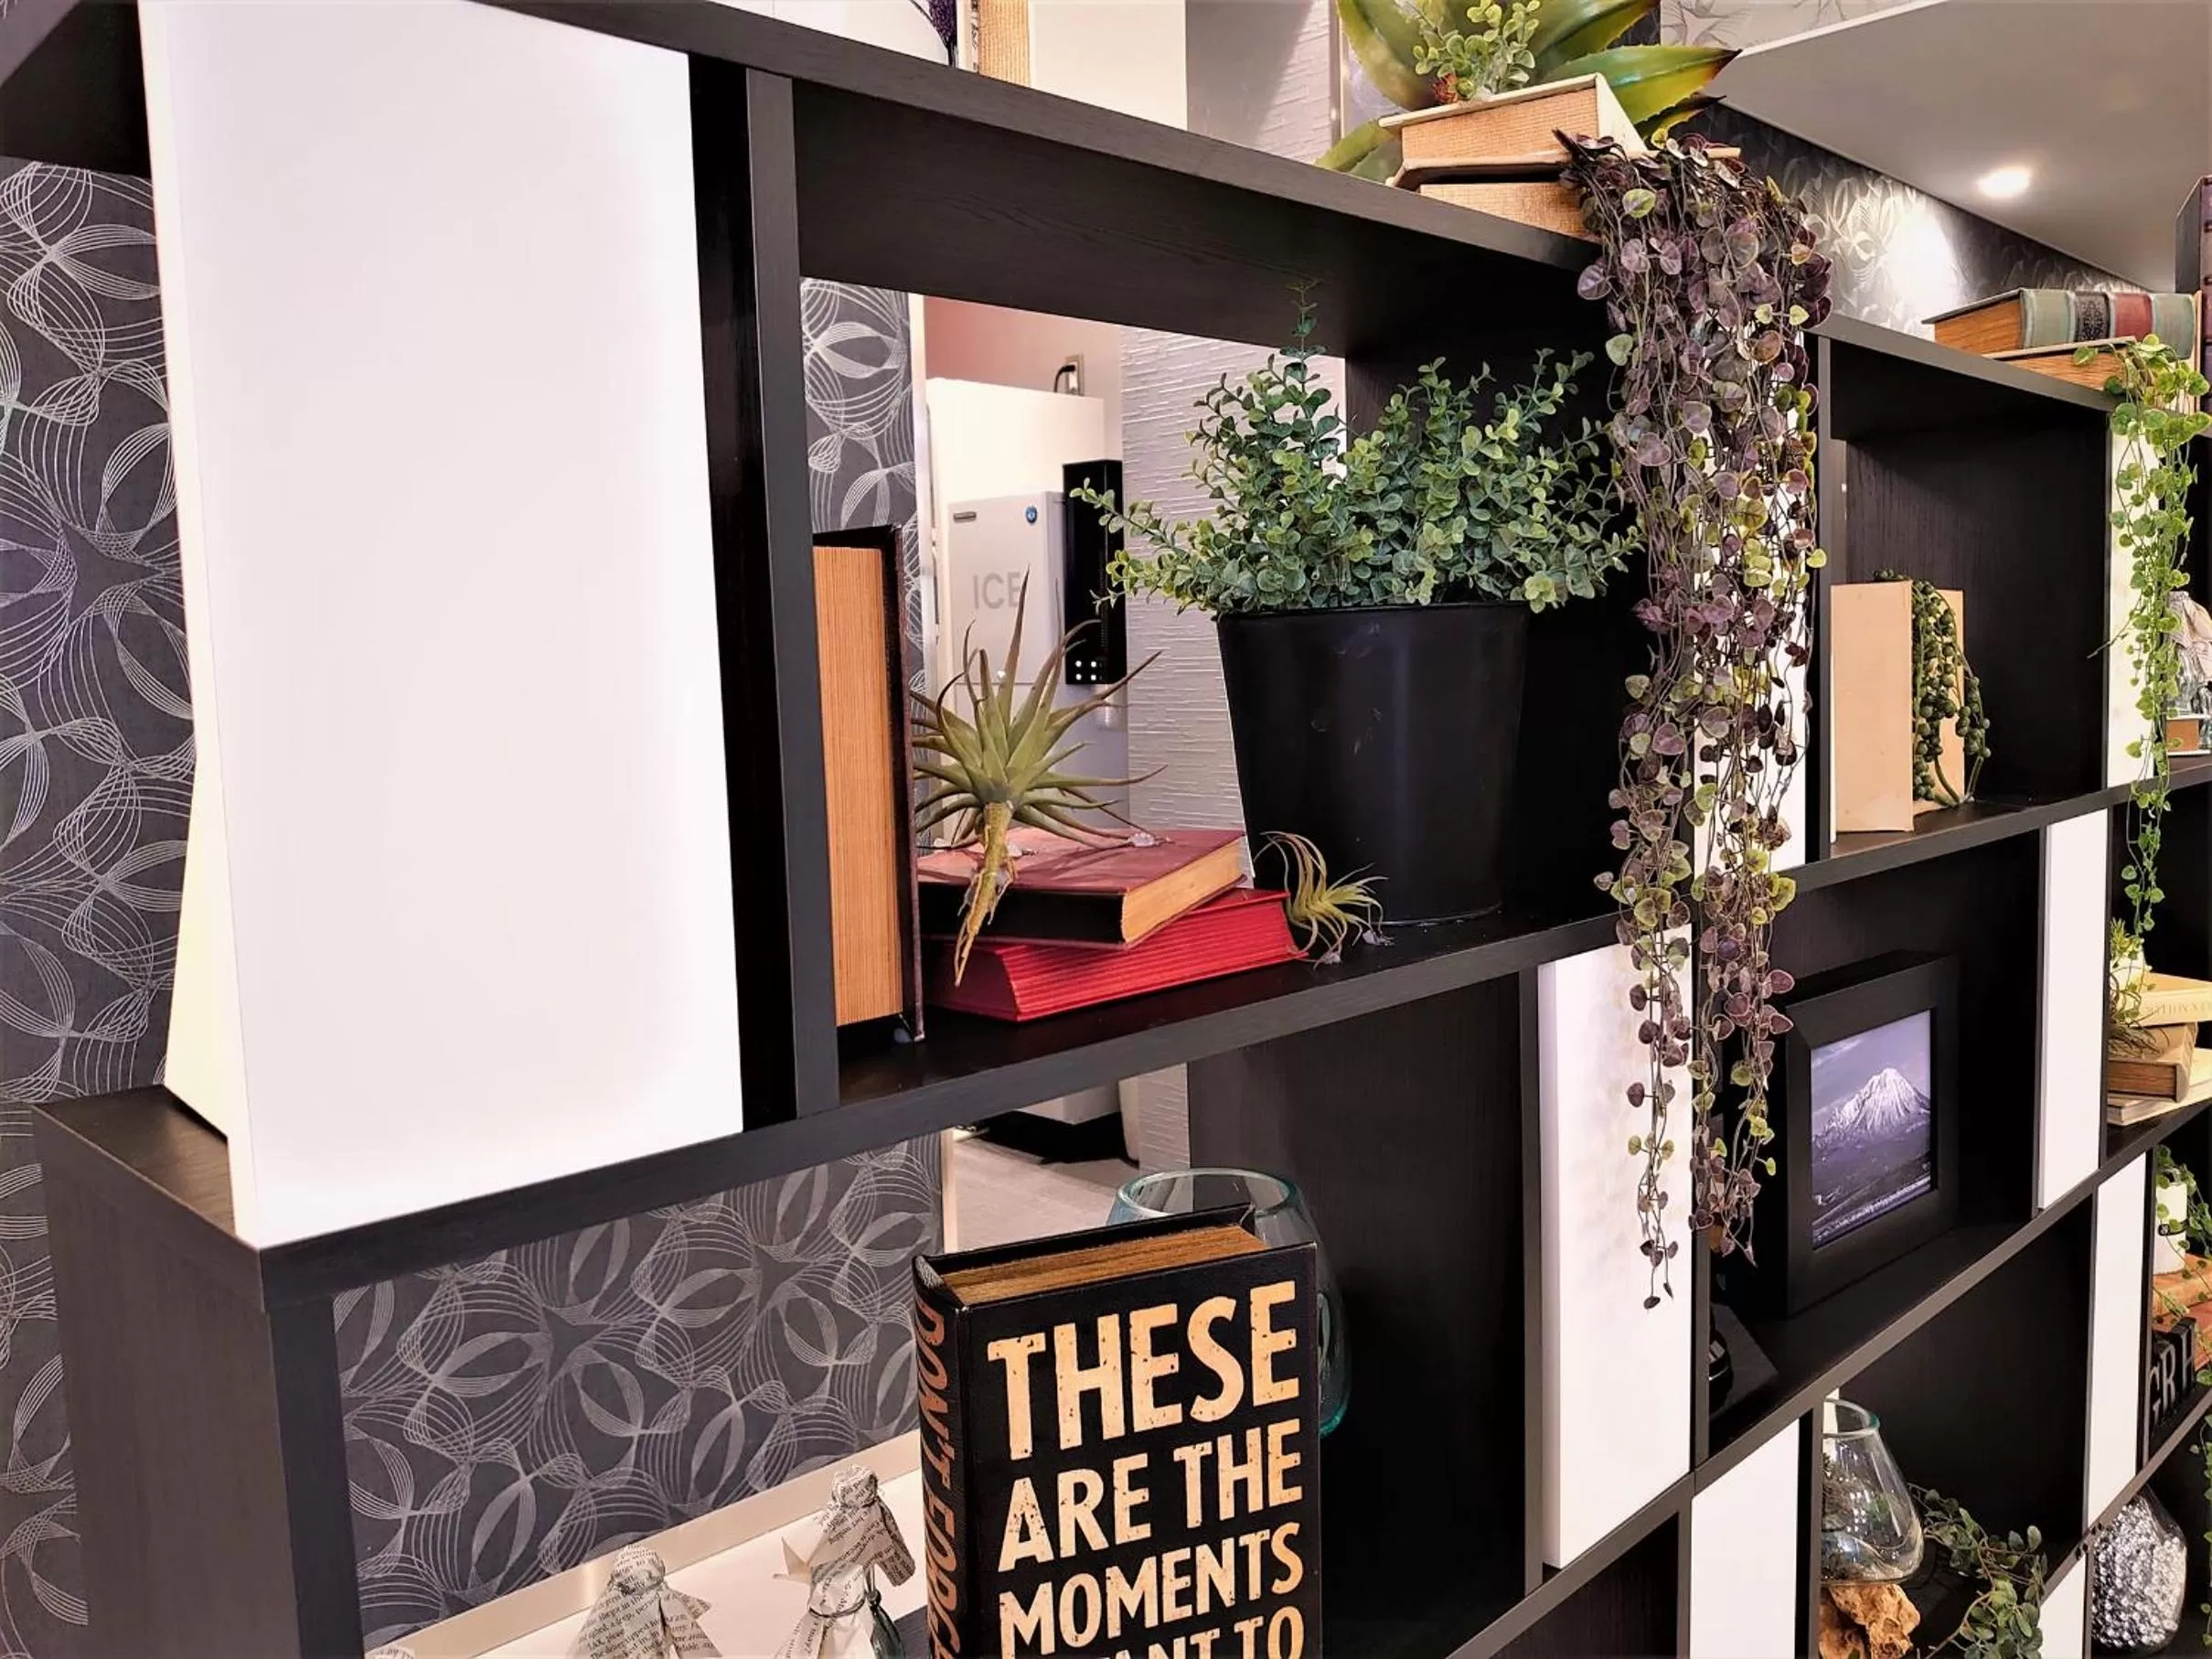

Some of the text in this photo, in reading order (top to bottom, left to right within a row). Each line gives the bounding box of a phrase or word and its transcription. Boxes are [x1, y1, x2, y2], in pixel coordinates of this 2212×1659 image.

[973, 572, 1022, 610] ICE
[915, 1290, 955, 1489] DON'T
[988, 1280, 1299, 1461] THESE
[998, 1452, 1151, 1572] ARE
[1173, 1418, 1303, 1528] THE
[999, 1522, 1304, 1659] MOMENTS
[1234, 1606, 1304, 1659] TO
